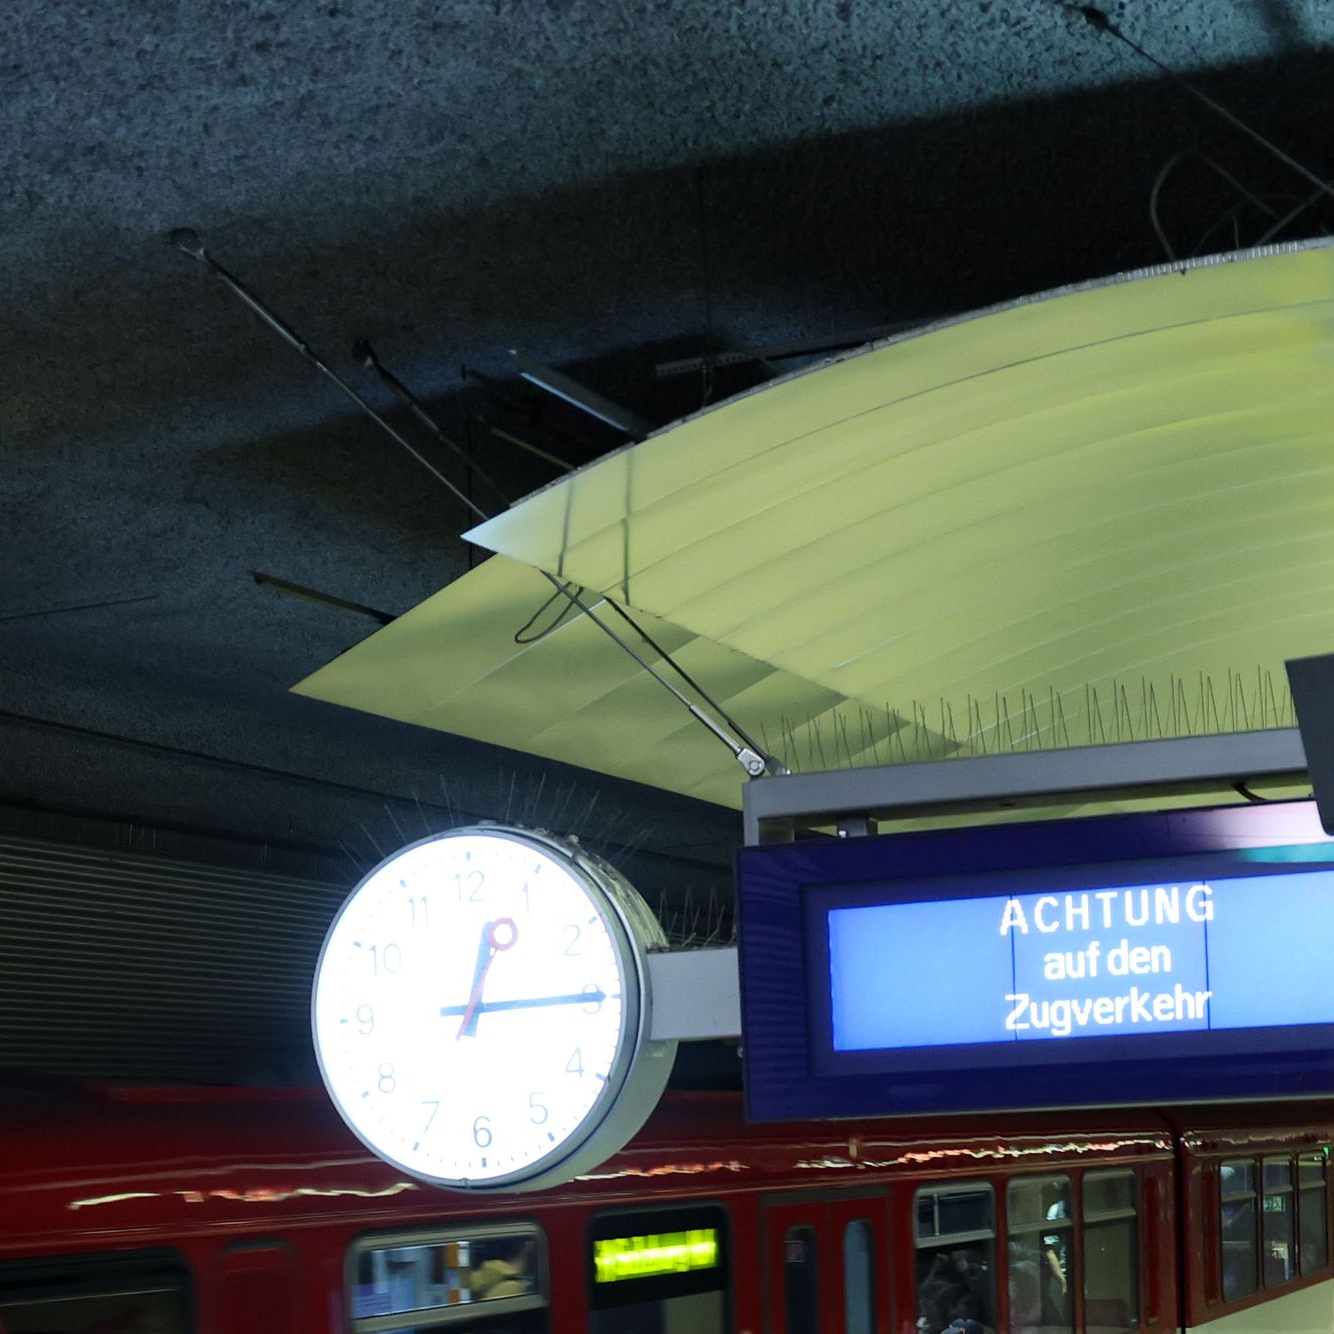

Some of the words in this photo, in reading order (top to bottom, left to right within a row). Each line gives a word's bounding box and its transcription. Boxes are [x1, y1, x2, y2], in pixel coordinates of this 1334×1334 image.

[454, 870, 485, 903] 12
[408, 896, 428, 928] 11
[1000, 884, 1214, 936] ACHTUNG
[563, 923, 583, 957] 2
[369, 942, 402, 976] 10
[1043, 940, 1101, 981] auf
[1106, 938, 1172, 977] den
[356, 1003, 375, 1036] 9
[1004, 983, 1213, 1037] Zugverkehr
[377, 1061, 397, 1094] 8
[565, 1046, 585, 1079] 4
[420, 1100, 441, 1134] 7
[529, 1092, 549, 1125] 5
[473, 1115, 493, 1148] 6
